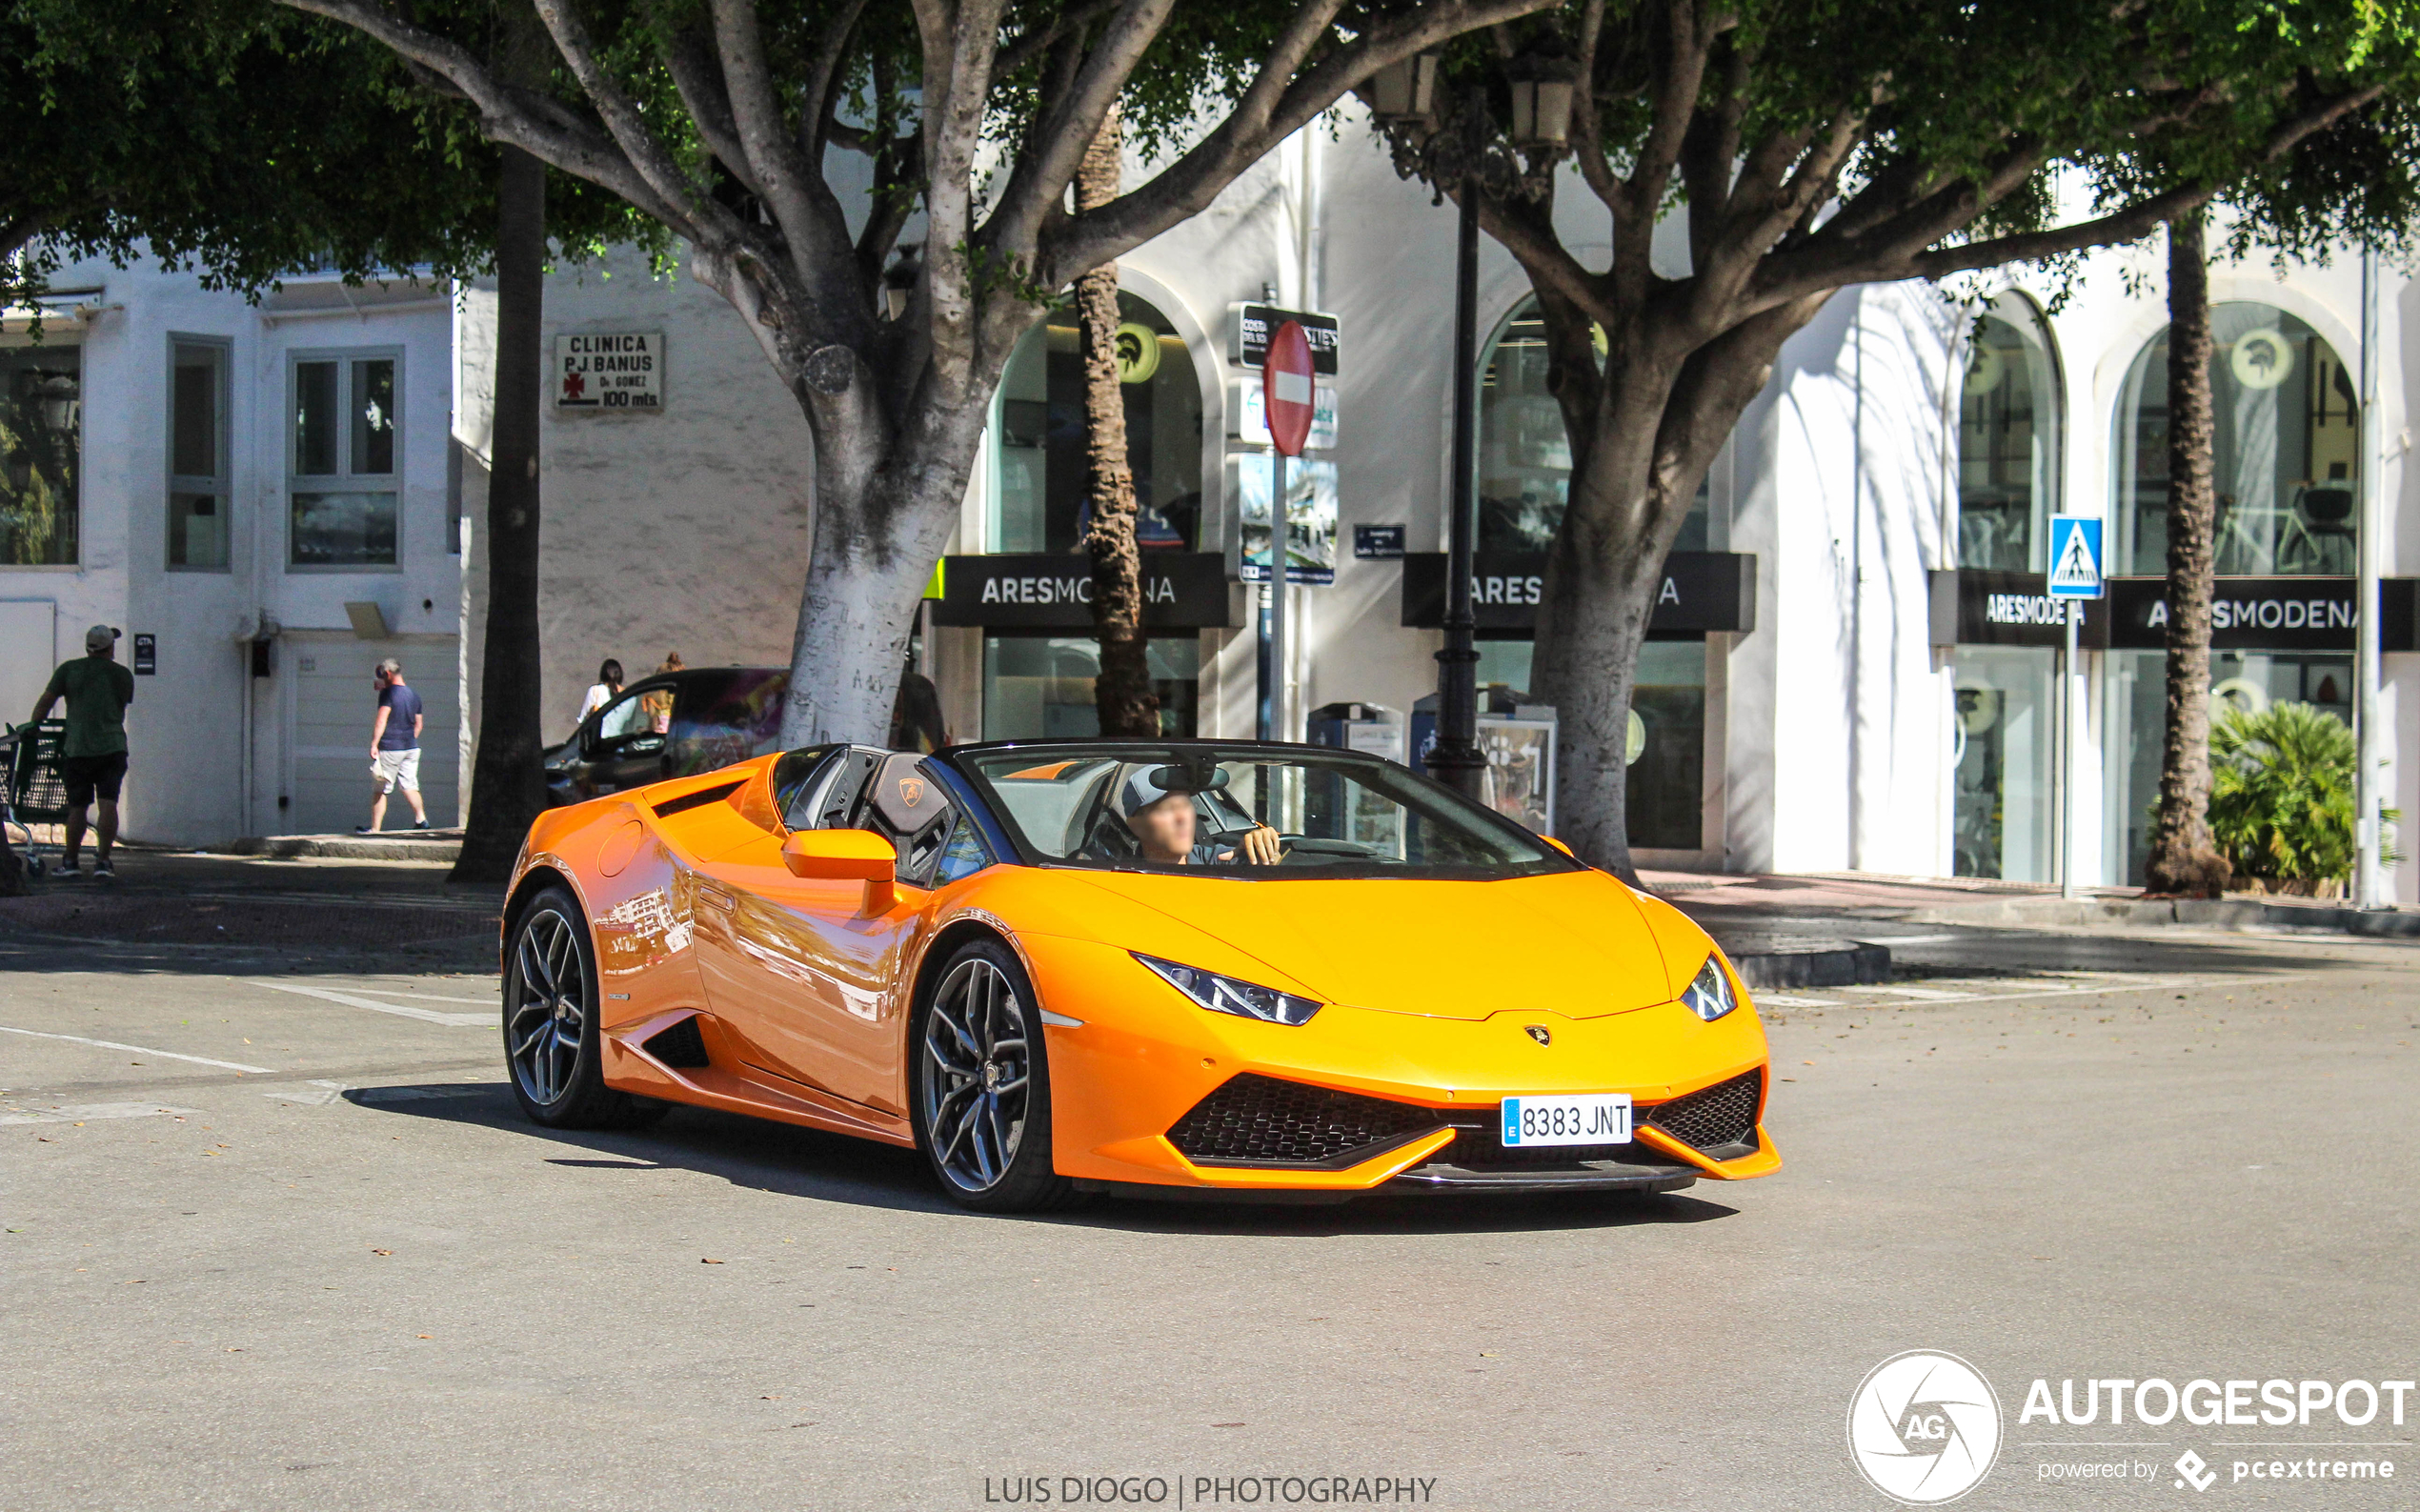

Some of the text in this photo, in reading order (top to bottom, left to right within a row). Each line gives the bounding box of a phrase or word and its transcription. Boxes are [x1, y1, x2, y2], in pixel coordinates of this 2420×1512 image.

[570, 336, 647, 353] CLINICA
[594, 355, 653, 373] BANUS
[615, 375, 646, 388] GOMEZ
[603, 391, 629, 407] 100
[1986, 594, 2087, 626] ARESMODEA
[1523, 1105, 1627, 1138] 8383 JNT
[1508, 1126, 1517, 1138] E
